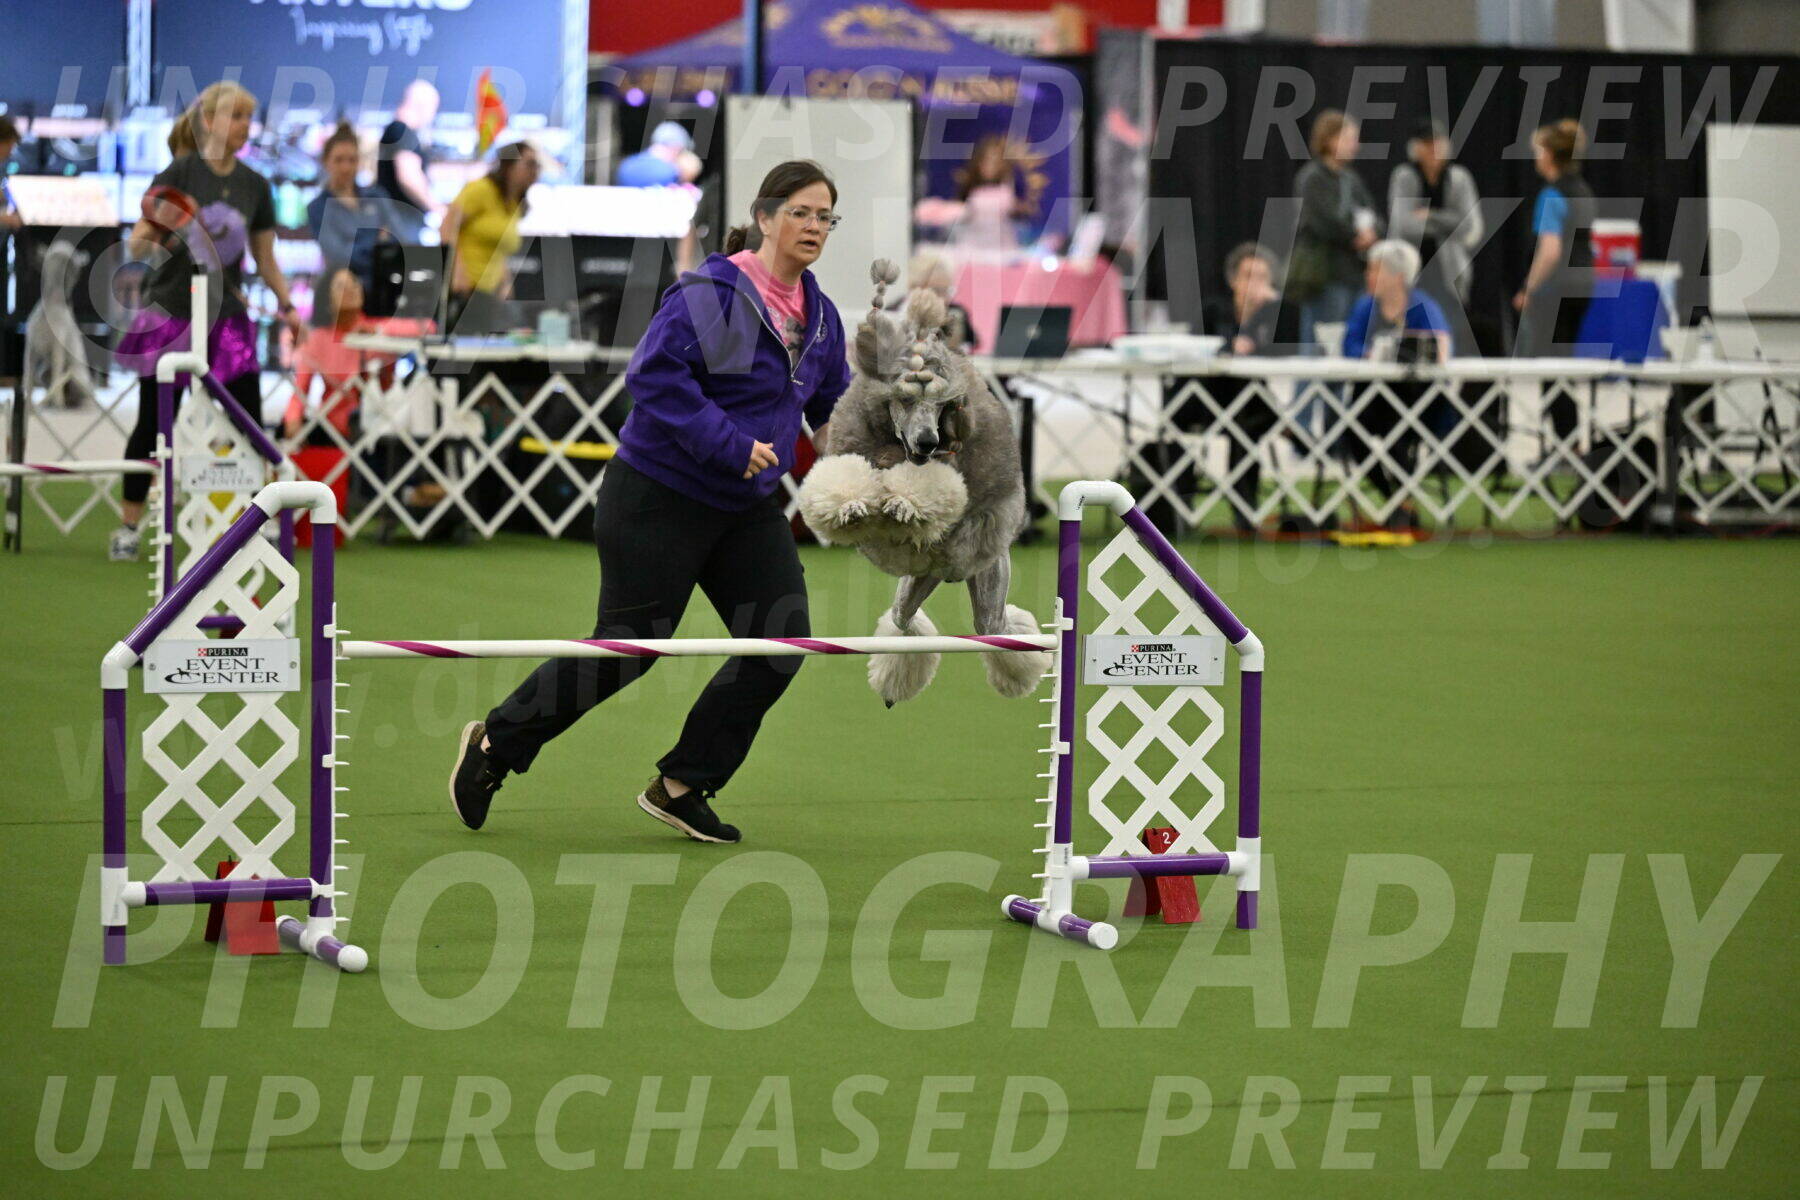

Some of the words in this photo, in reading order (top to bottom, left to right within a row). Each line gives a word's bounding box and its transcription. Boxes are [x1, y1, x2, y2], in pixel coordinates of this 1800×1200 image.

[208, 648, 248, 656] PURINA
[1139, 644, 1173, 652] PURINA
[186, 658, 265, 670] EVENT
[1121, 653, 1187, 664] EVENT
[1103, 663, 1200, 676] CENTER
[164, 671, 282, 684] CENTER
[1162, 831, 1172, 844] 2
